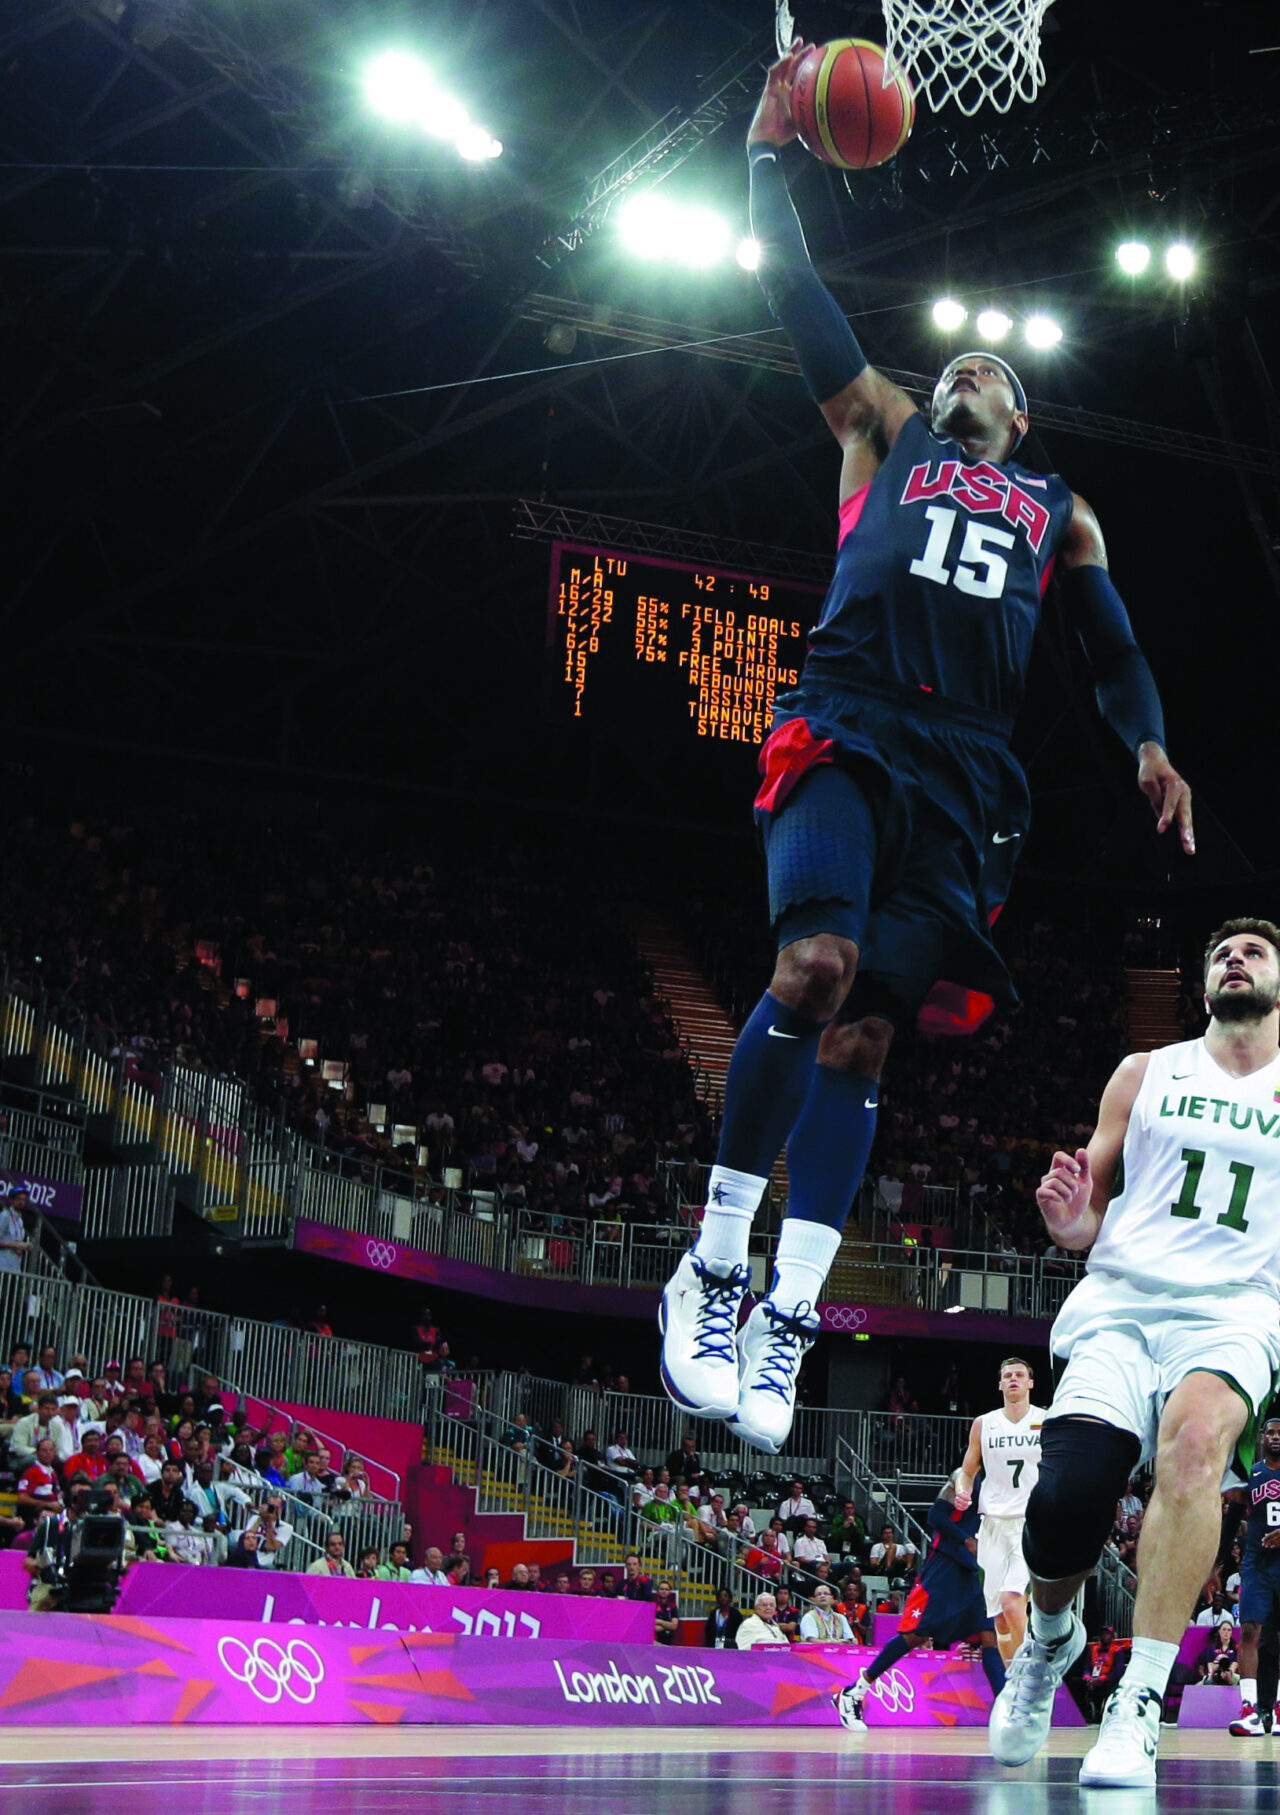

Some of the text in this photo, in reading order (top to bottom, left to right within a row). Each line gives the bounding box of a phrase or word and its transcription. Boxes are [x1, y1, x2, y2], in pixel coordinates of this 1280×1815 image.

[899, 460, 1050, 555] USA
[594, 556, 627, 576] LTU
[909, 505, 1016, 599] 15
[571, 568, 603, 588] M/A
[694, 574, 715, 591] 42
[750, 583, 769, 601] 49
[558, 599, 778, 650] 12/22 55% 2 POINTS
[559, 583, 800, 637] 16/29 55% FIELD GOALS
[566, 633, 798, 685] 6/8 75% FREE THROWS
[568, 616, 777, 666] 4/7 57% 3 POINTS
[565, 666, 774, 713] 13 ASSISTS
[566, 650, 775, 697] 15 REBOUNDS
[575, 684, 584, 699] 7
[574, 700, 762, 744] 1 STEALS
[1170, 1148, 1255, 1234] 11
[989, 1435, 1041, 1449] LIETUVA
[1006, 1460, 1024, 1488] 7
[553, 1660, 722, 1704] London 2012
